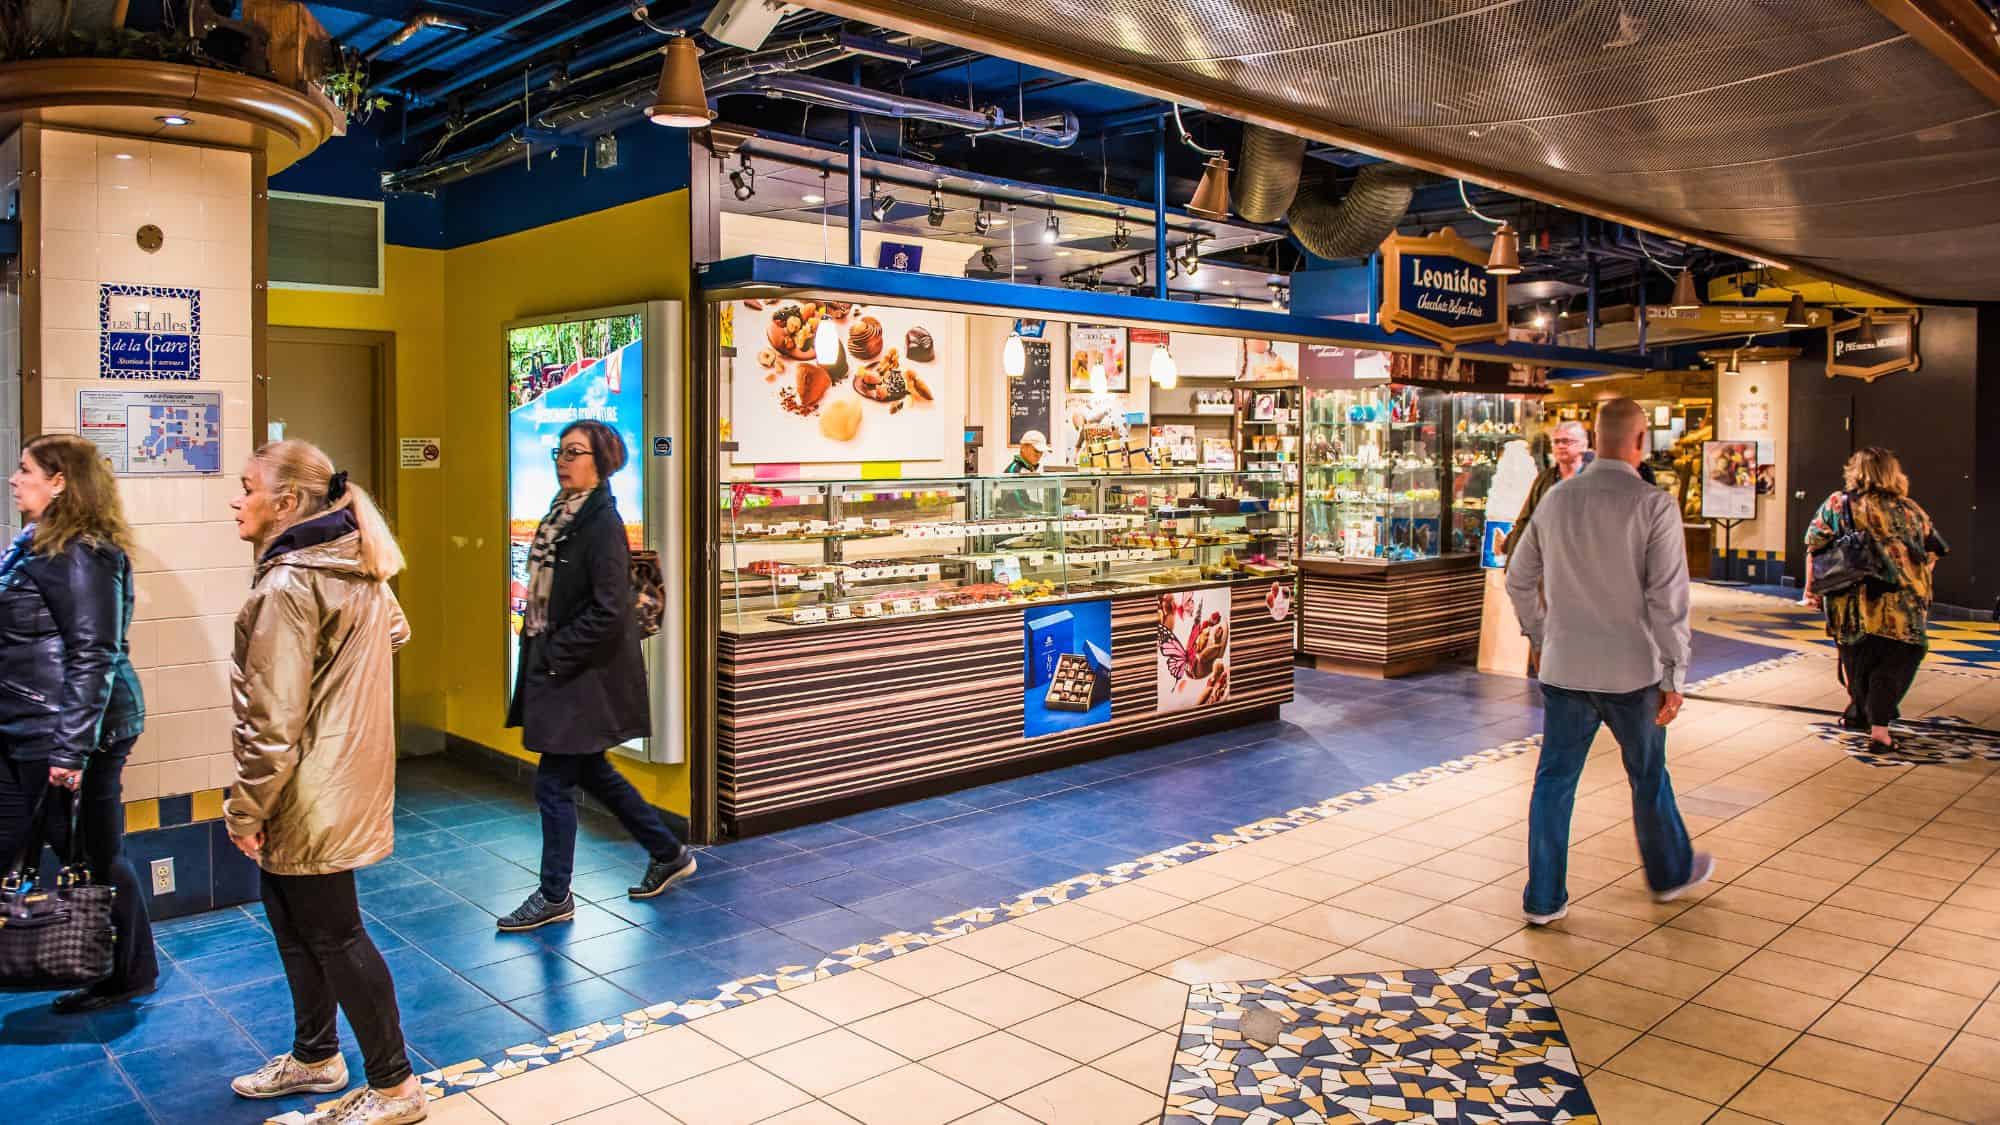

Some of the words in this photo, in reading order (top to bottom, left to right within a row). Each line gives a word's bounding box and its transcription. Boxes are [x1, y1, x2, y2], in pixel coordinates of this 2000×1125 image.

[1413, 259, 1487, 297] Leonidas
[112, 320, 132, 330] LES
[134, 311, 187, 332] Halles
[111, 338, 127, 352] de
[128, 338, 141, 352] la
[144, 335, 188, 354] Gare
